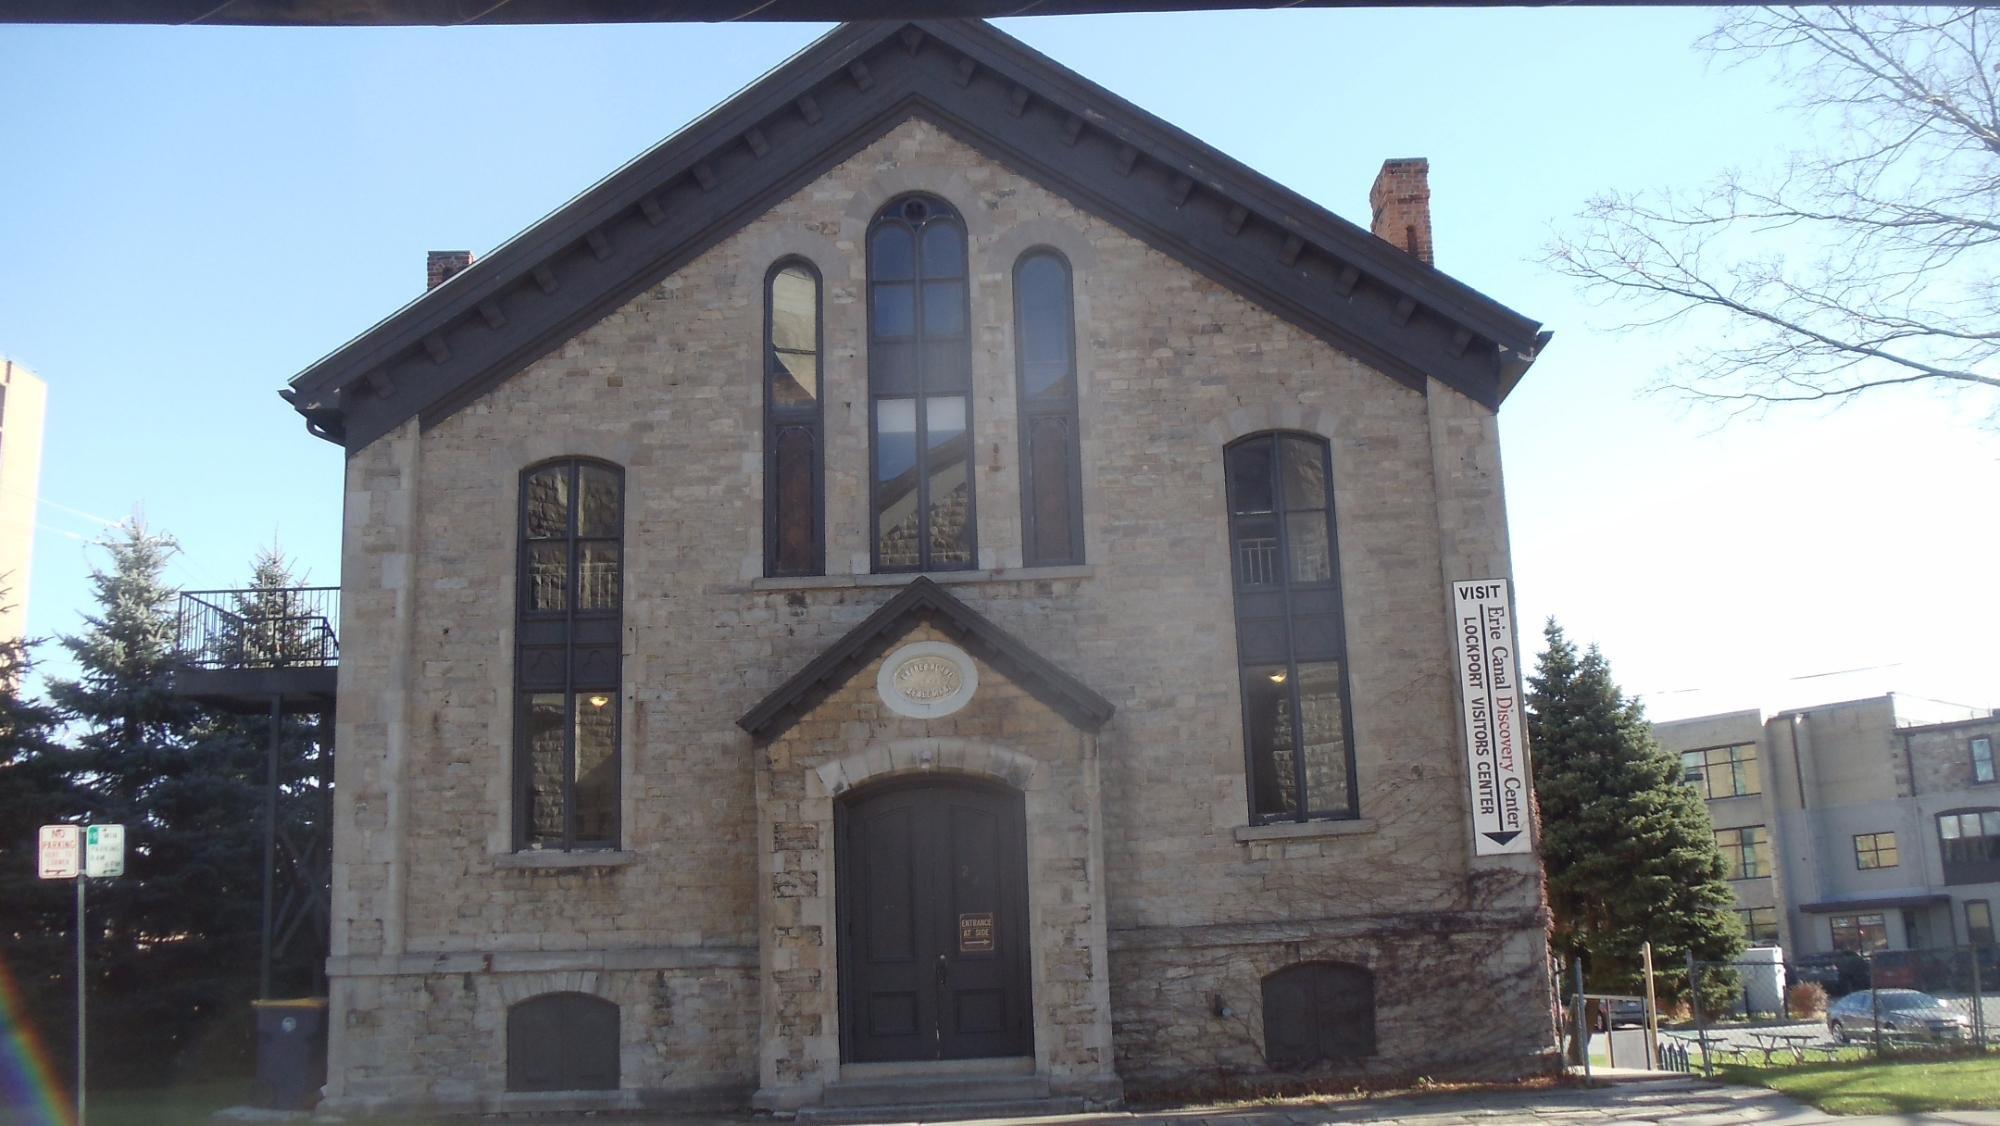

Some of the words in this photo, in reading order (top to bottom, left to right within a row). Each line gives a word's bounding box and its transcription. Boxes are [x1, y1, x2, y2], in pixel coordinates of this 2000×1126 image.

[1459, 585, 1500, 600] VISIT
[1488, 606, 1505, 640] Erie
[1464, 617, 1483, 689] LOCKPORT
[1491, 646, 1511, 690] Canal
[1471, 697, 1489, 757] VISITORS
[1496, 696, 1515, 772] Discovery
[1477, 761, 1494, 815] CENTER
[1504, 777, 1521, 828] Center
[961, 919, 992, 928] ENTRANCE
[976, 928, 990, 936] SIDE
